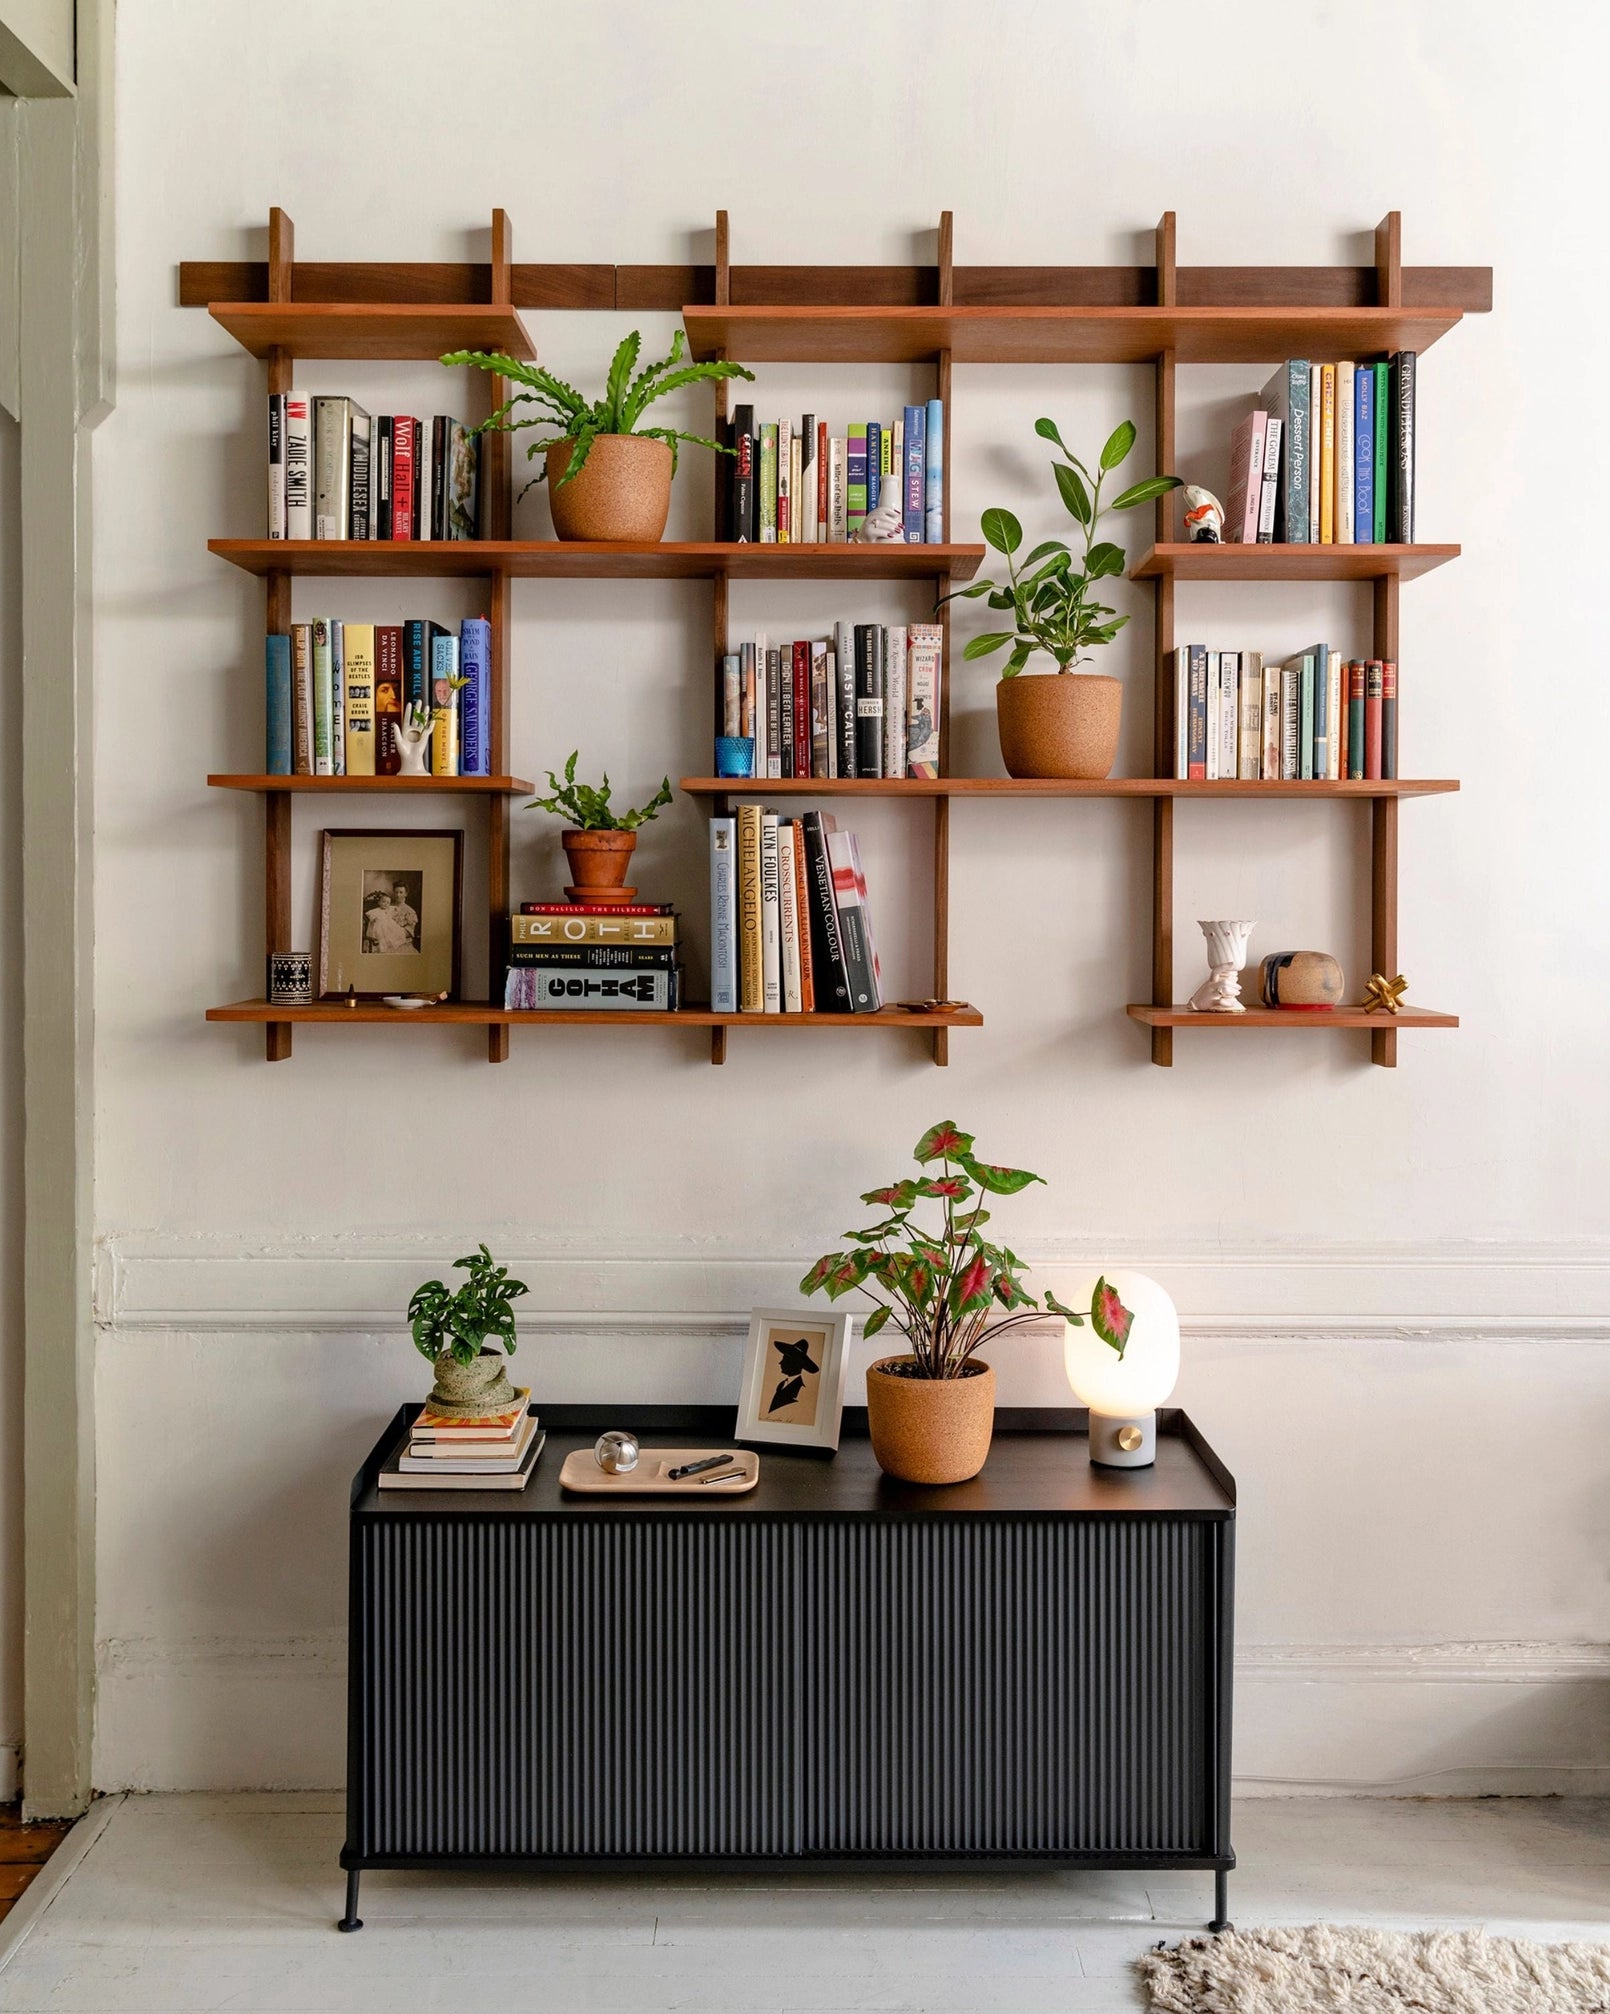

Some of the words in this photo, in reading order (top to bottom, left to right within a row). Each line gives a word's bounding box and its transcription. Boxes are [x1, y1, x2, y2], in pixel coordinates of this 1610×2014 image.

[1401, 364, 1412, 409] GRAND
[270, 411, 280, 428] phil
[287, 402, 308, 420] NW
[270, 430, 280, 447] klay
[395, 421, 412, 458] Wolf
[1270, 421, 1279, 438] THE
[1294, 408, 1305, 450] Dessert
[1400, 411, 1412, 470] ILLUSIONS
[288, 435, 308, 466] ZADIE
[883, 438, 891, 475] ANNIHIL
[1267, 439, 1278, 470] GOLEM
[1358, 433, 1371, 462] COOK
[353, 453, 369, 512] MIDDLESEX
[394, 463, 411, 492] Hall
[833, 463, 844, 483] Valley
[1294, 452, 1304, 490] Person
[1358, 466, 1371, 481] THIS
[288, 470, 308, 507] SMITH
[834, 492, 844, 504] the
[911, 479, 919, 509] STEW
[1358, 485, 1371, 515] BOOK
[834, 505, 844, 526] Dolls
[1402, 505, 1410, 536] BONANZA
[296, 627, 306, 649] PHILIP
[382, 635, 388, 646] DA
[412, 623, 422, 646] RISE
[891, 637, 899, 650] The
[297, 649, 306, 668] ROTH
[412, 648, 422, 671] AND
[436, 643, 445, 672] SACKS
[464, 652, 479, 660] RAIN
[890, 651, 900, 677] Known
[1191, 659, 1198, 669] TO
[297, 669, 306, 682] THE
[412, 673, 422, 696] KILL
[465, 664, 478, 704] GEORGE
[844, 664, 853, 700] LAST
[891, 677, 901, 699] World
[1191, 671, 1199, 697] ARMS
[1197, 660, 1205, 703] FAREWELL
[1223, 662, 1232, 698] HEMINGWAY
[298, 682, 307, 699] PLOT
[783, 693, 791, 711] BEN
[298, 700, 307, 727] AGAINST
[770, 700, 779, 709] THE
[770, 710, 779, 722] WINE
[828, 695, 836, 740] IRONWEED
[858, 706, 882, 715] HERSH
[465, 706, 478, 759] SAUNDERS
[770, 730, 779, 753] SOLITUDE
[783, 712, 791, 746] LERNER
[844, 711, 854, 747] CALL
[298, 728, 308, 757] AMERICA
[763, 825, 777, 850] LLYN
[716, 862, 730, 893] CHARLES
[743, 807, 757, 931] MICHELANGELO
[763, 856, 778, 903] FOULKES
[781, 845, 794, 943] CROSSCURRENTS
[717, 895, 730, 920] RENNIE
[815, 855, 832, 912] VENETIAN
[824, 913, 840, 962] COLOUR
[519, 916, 527, 940] PHILIP
[530, 918, 655, 940] ROTH
[586, 917, 596, 940] BLAKE
[623, 916, 632, 942] BAILEY
[717, 923, 730, 969] MACKINTOSH
[549, 976, 655, 1002] GOTHAM
